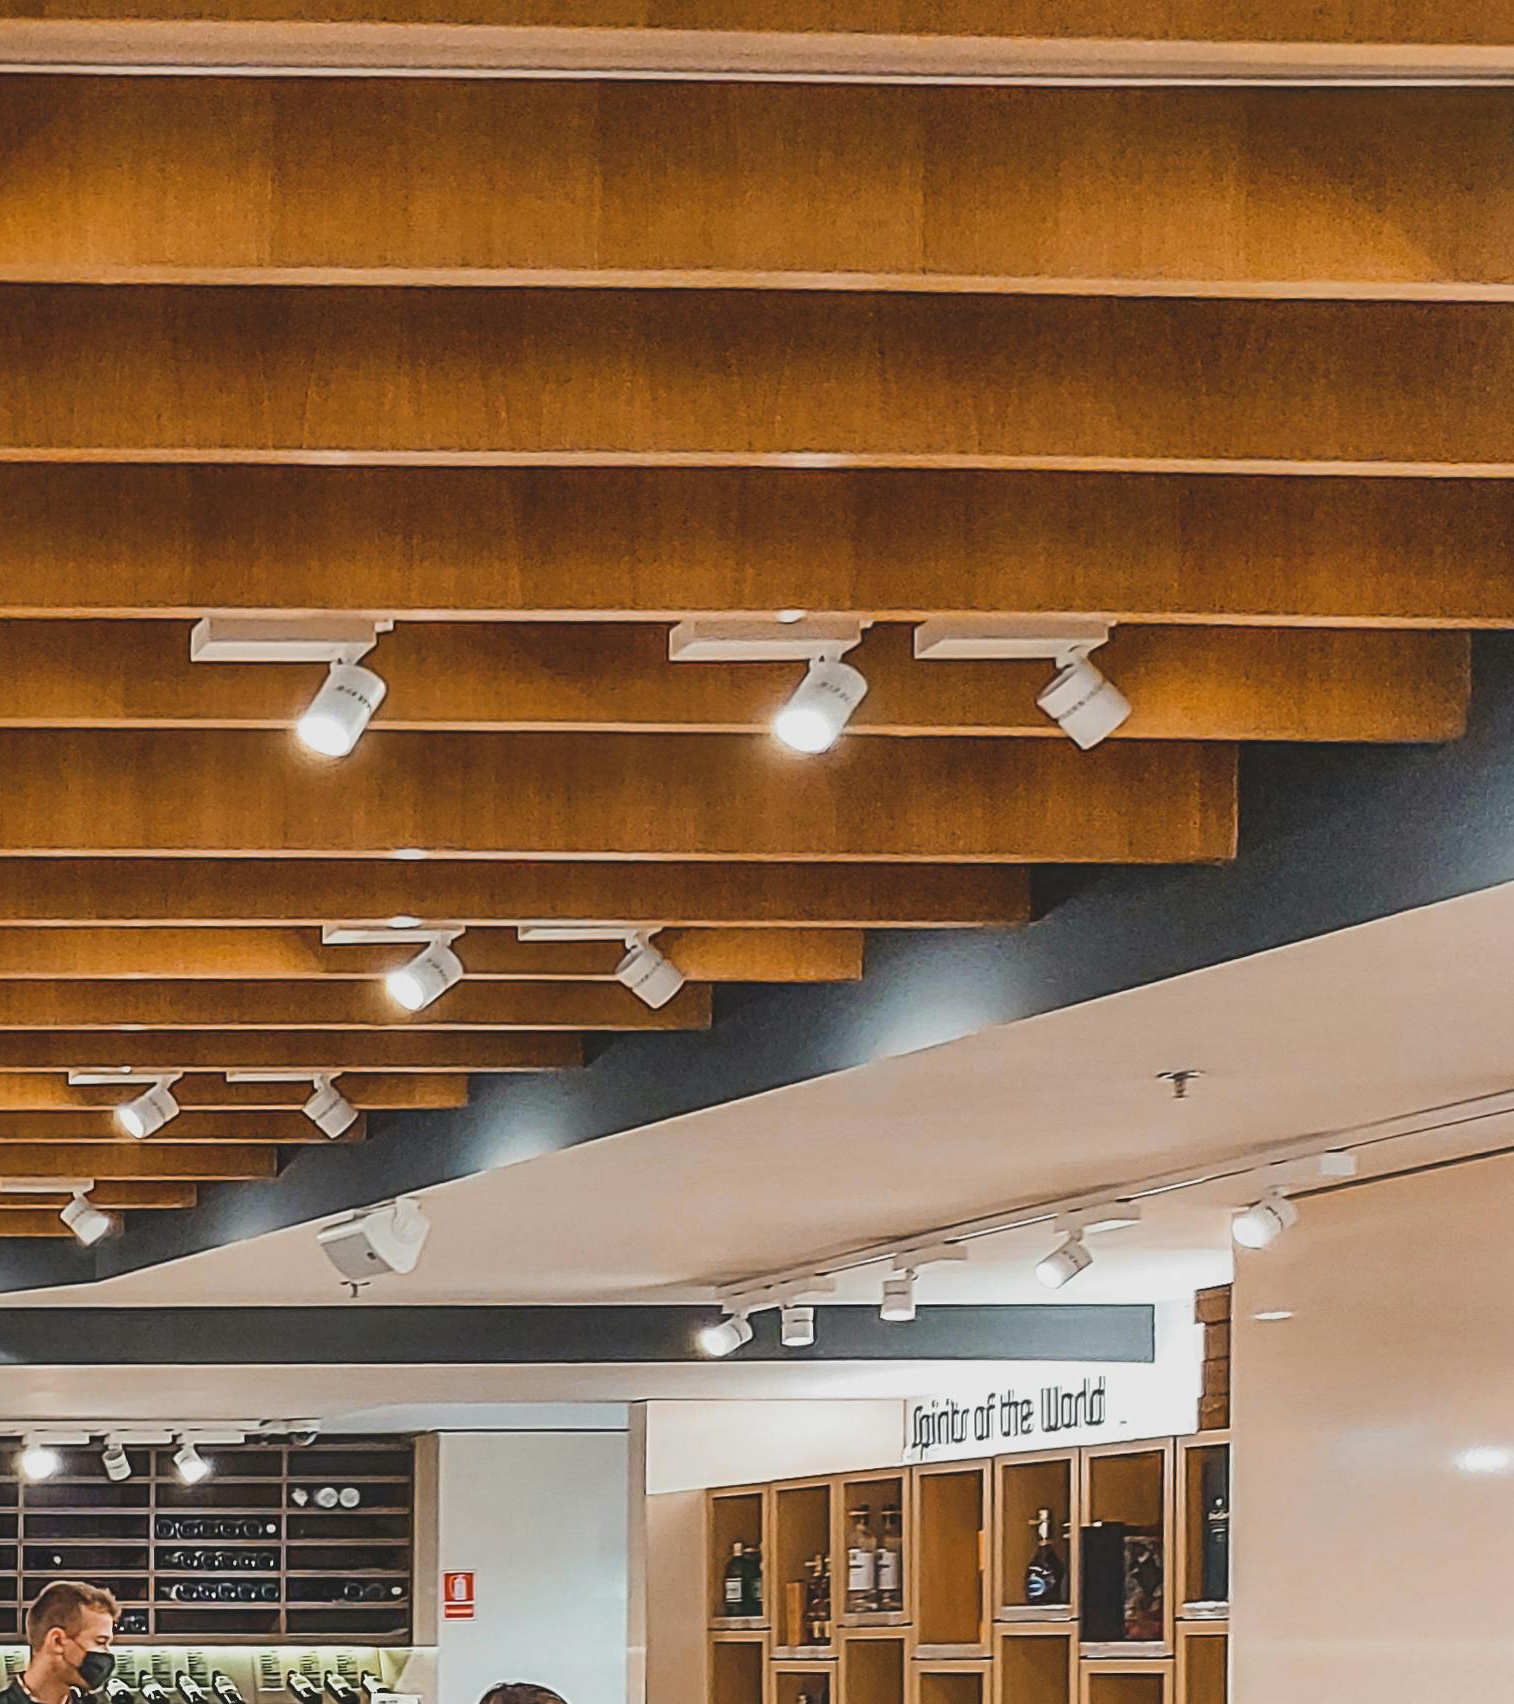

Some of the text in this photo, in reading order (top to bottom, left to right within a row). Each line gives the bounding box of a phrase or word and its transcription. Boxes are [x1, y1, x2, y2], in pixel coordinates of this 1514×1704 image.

[912, 1376, 1106, 1461] Spirits of the World
